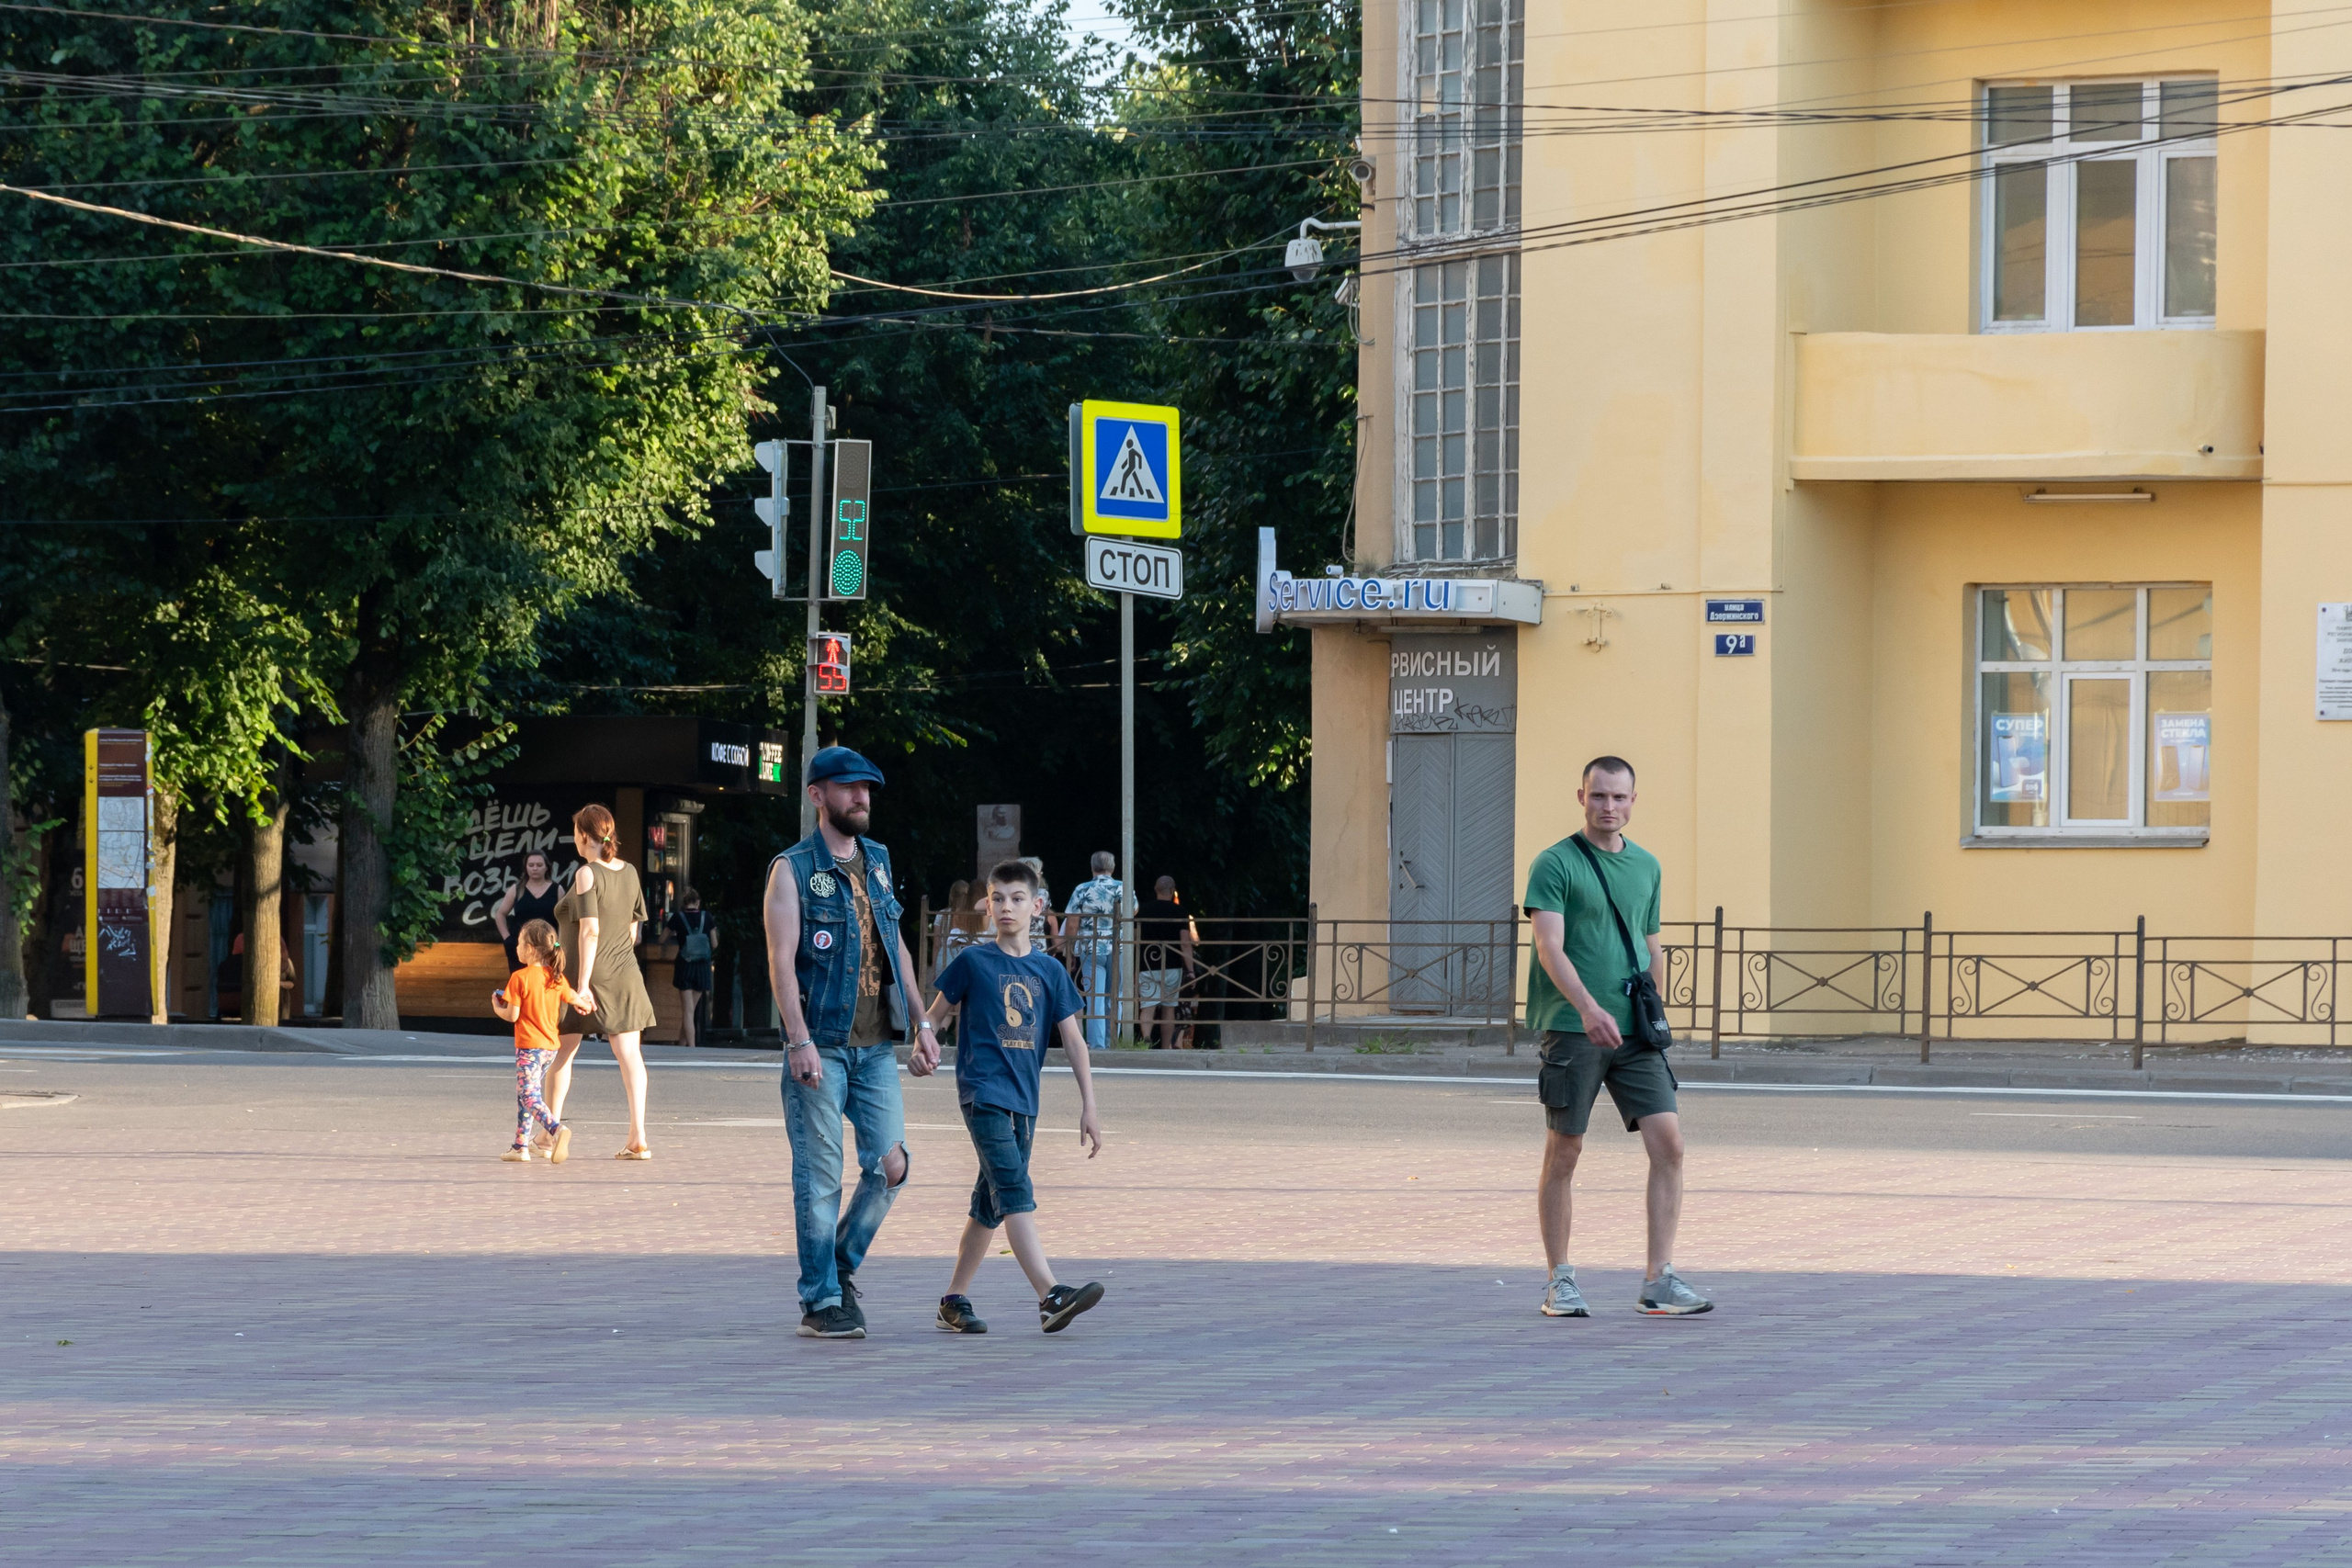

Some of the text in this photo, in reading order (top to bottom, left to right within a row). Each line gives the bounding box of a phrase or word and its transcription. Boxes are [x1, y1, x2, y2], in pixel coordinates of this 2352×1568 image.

[1099, 548, 1170, 588] СТОП
[1268, 571, 1450, 612] Service.ru
[1710, 612, 1758, 621] Дзержинского
[1391, 645, 1500, 677] РВИСНЫЙ
[1395, 688, 1453, 718] ЦЕНТР
[1996, 719, 2043, 731] СУПЕР
[2161, 718, 2206, 728] ЗАМЕНА
[2161, 728, 2207, 738] СТЕКЛА
[711, 742, 727, 763] КОФЕ
[730, 744, 749, 767] СОБОЙ
[465, 799, 551, 835] ДЁШЬ
[444, 861, 579, 897] ВОЗЬИ
[999, 975, 1041, 996] KING
[1012, 994, 1030, 1011] OF
